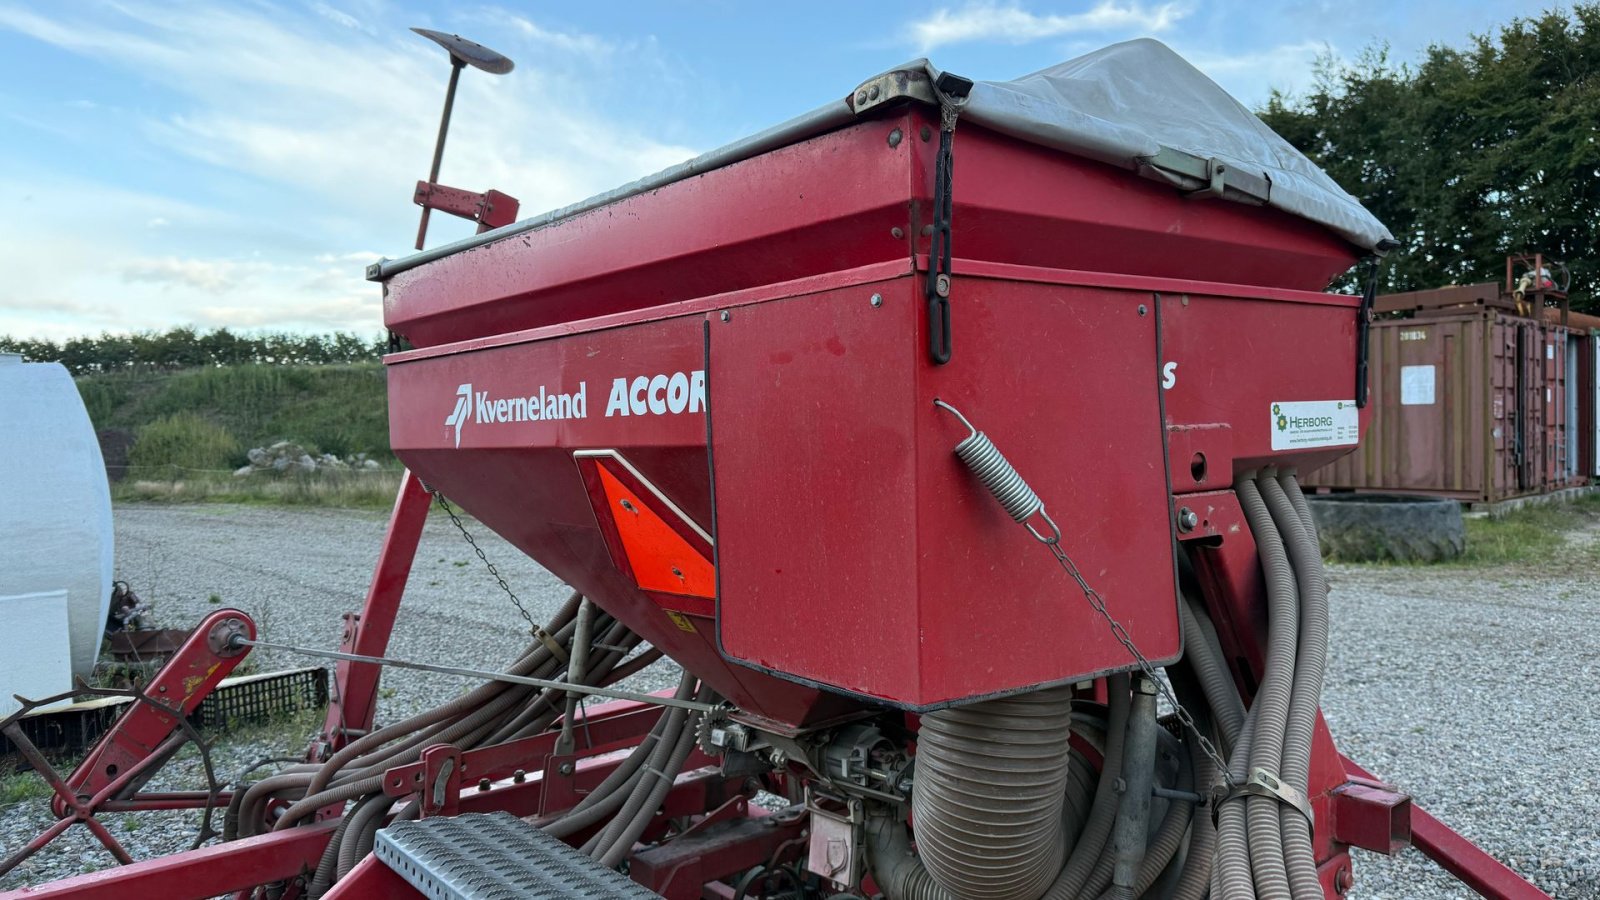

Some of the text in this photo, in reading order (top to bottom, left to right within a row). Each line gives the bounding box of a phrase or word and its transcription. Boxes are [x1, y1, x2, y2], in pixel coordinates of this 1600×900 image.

[475, 370, 707, 424] Kverneland ACCOR
[1289, 416, 1333, 429] HERBORG
